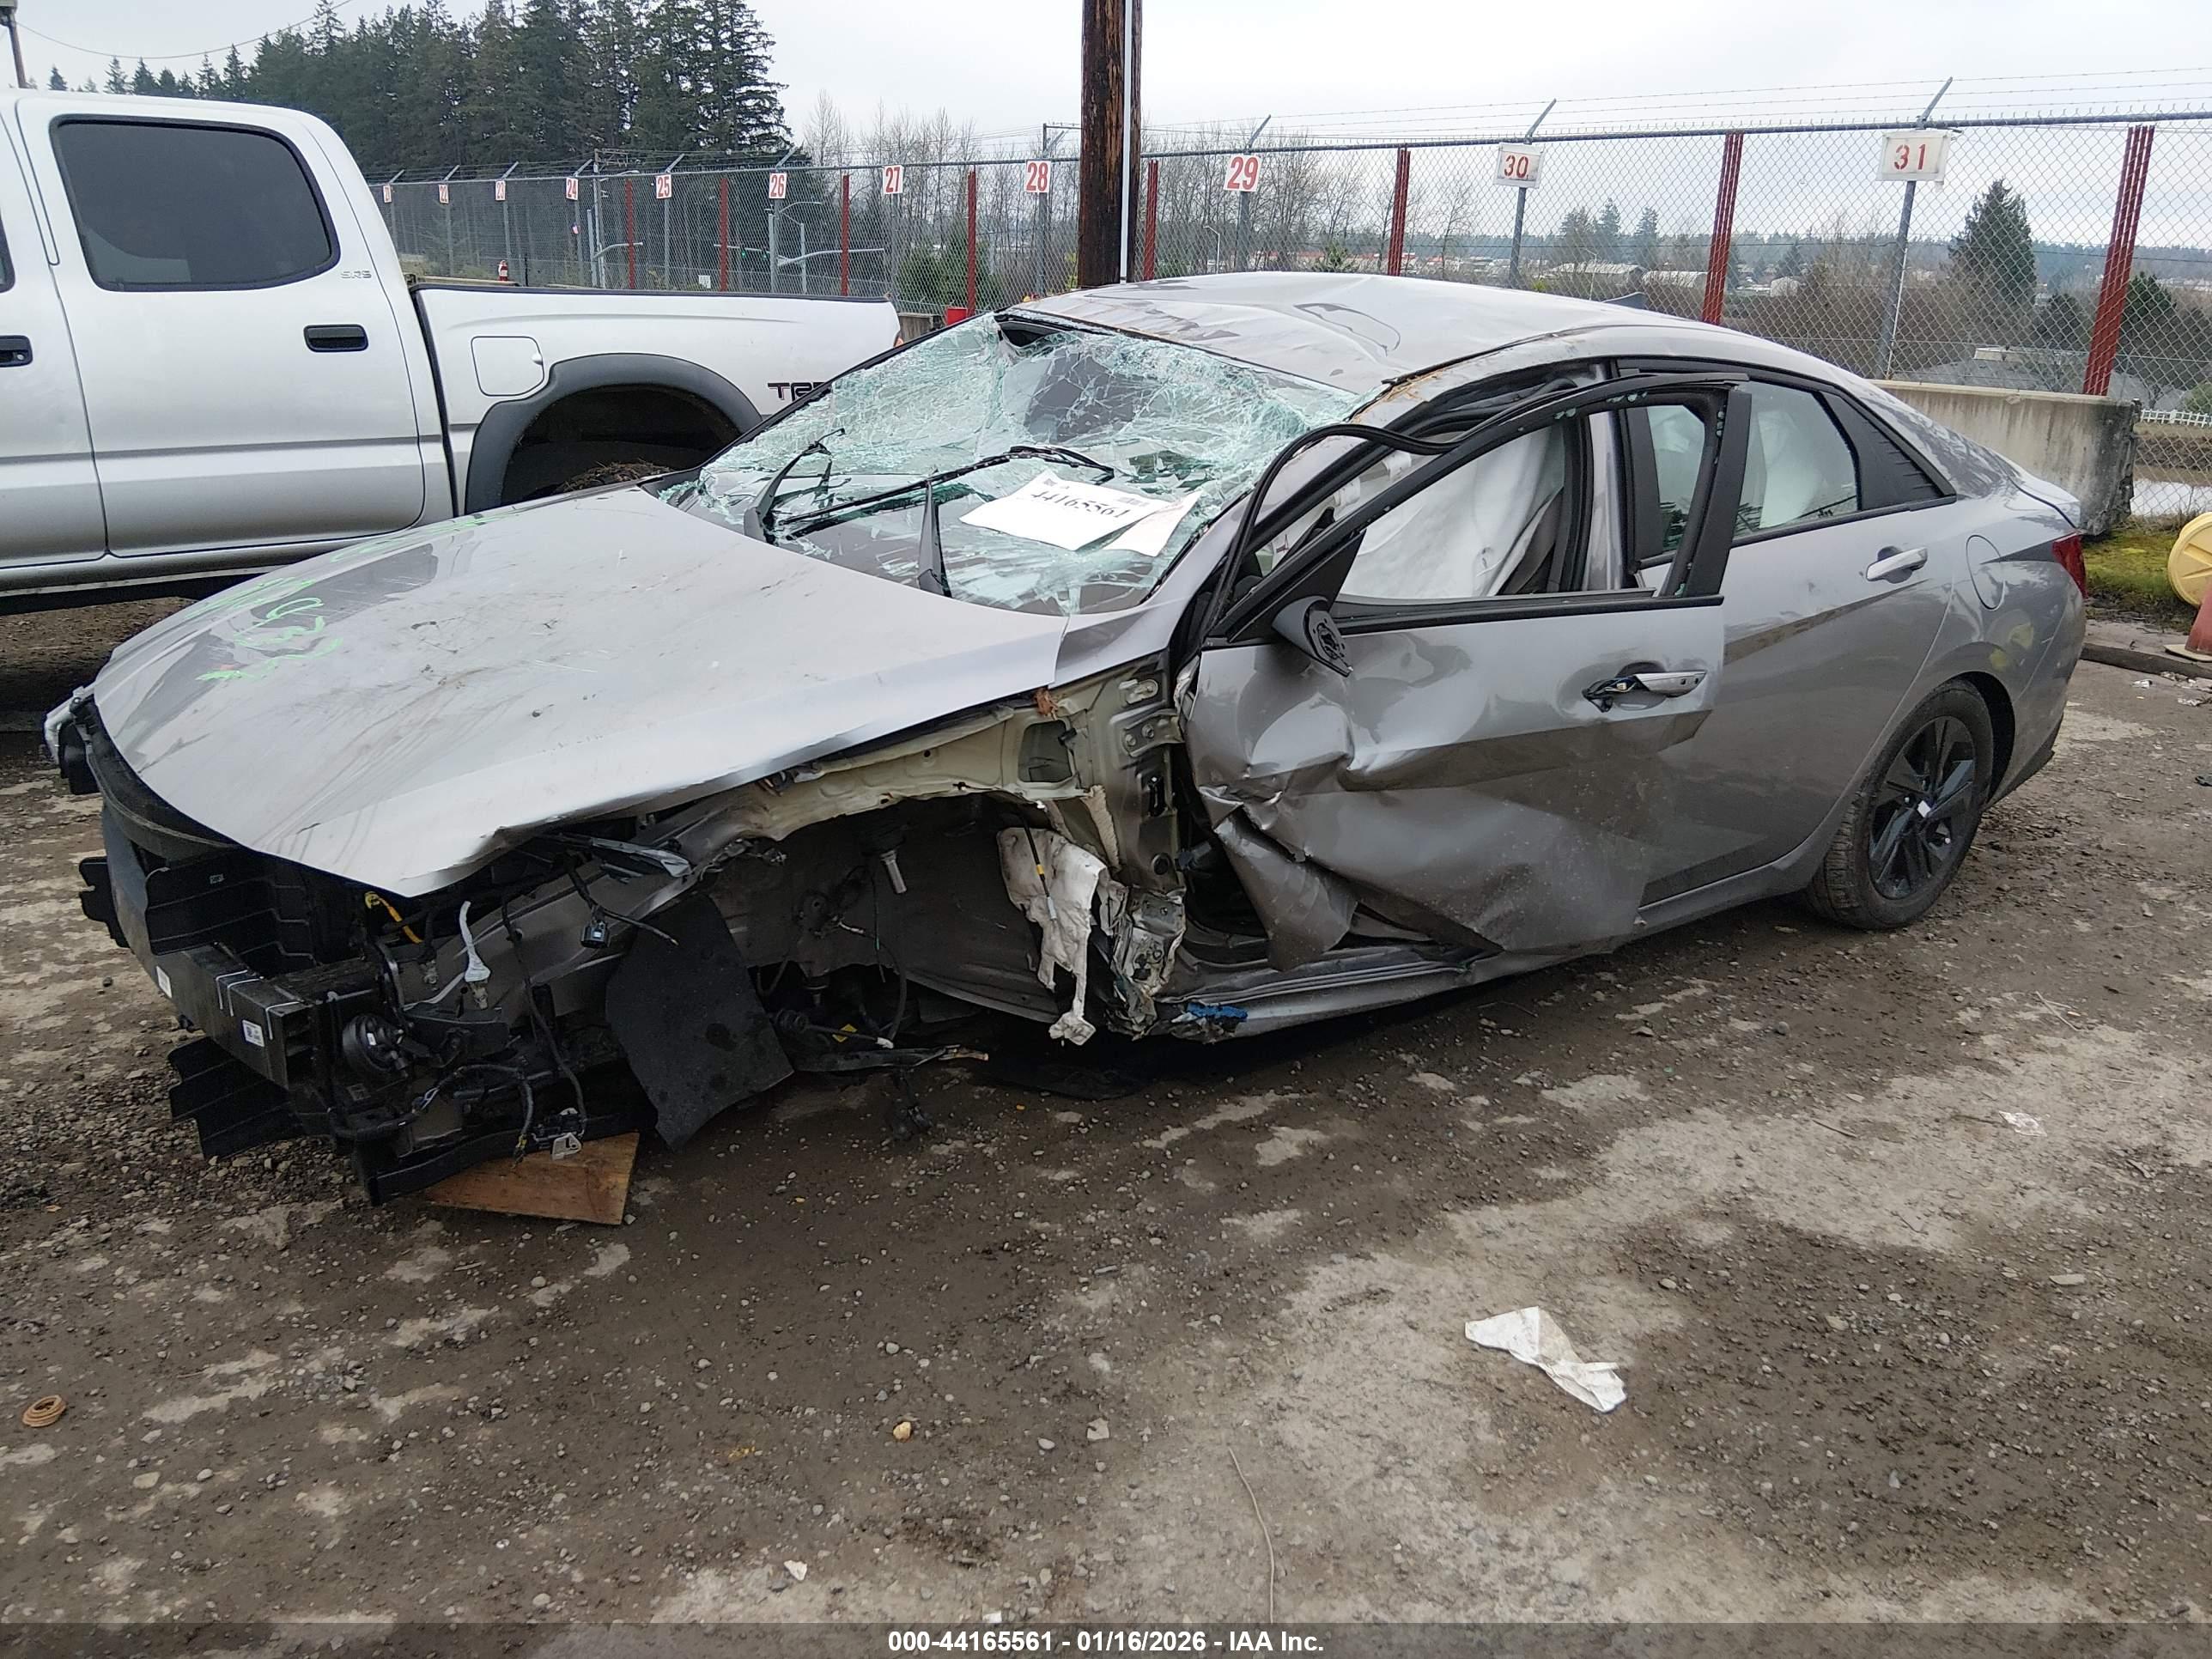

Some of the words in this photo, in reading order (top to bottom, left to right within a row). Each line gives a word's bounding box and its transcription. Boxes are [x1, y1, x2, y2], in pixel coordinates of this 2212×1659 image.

[1504, 155, 1528, 179] 30
[1894, 143, 1926, 170] 31
[770, 174, 785, 198] 26
[885, 167, 901, 193] 27
[1025, 162, 1048, 191] 28
[1226, 156, 1259, 191] 29
[567, 179, 577, 199] 24
[657, 176, 671, 198] 25
